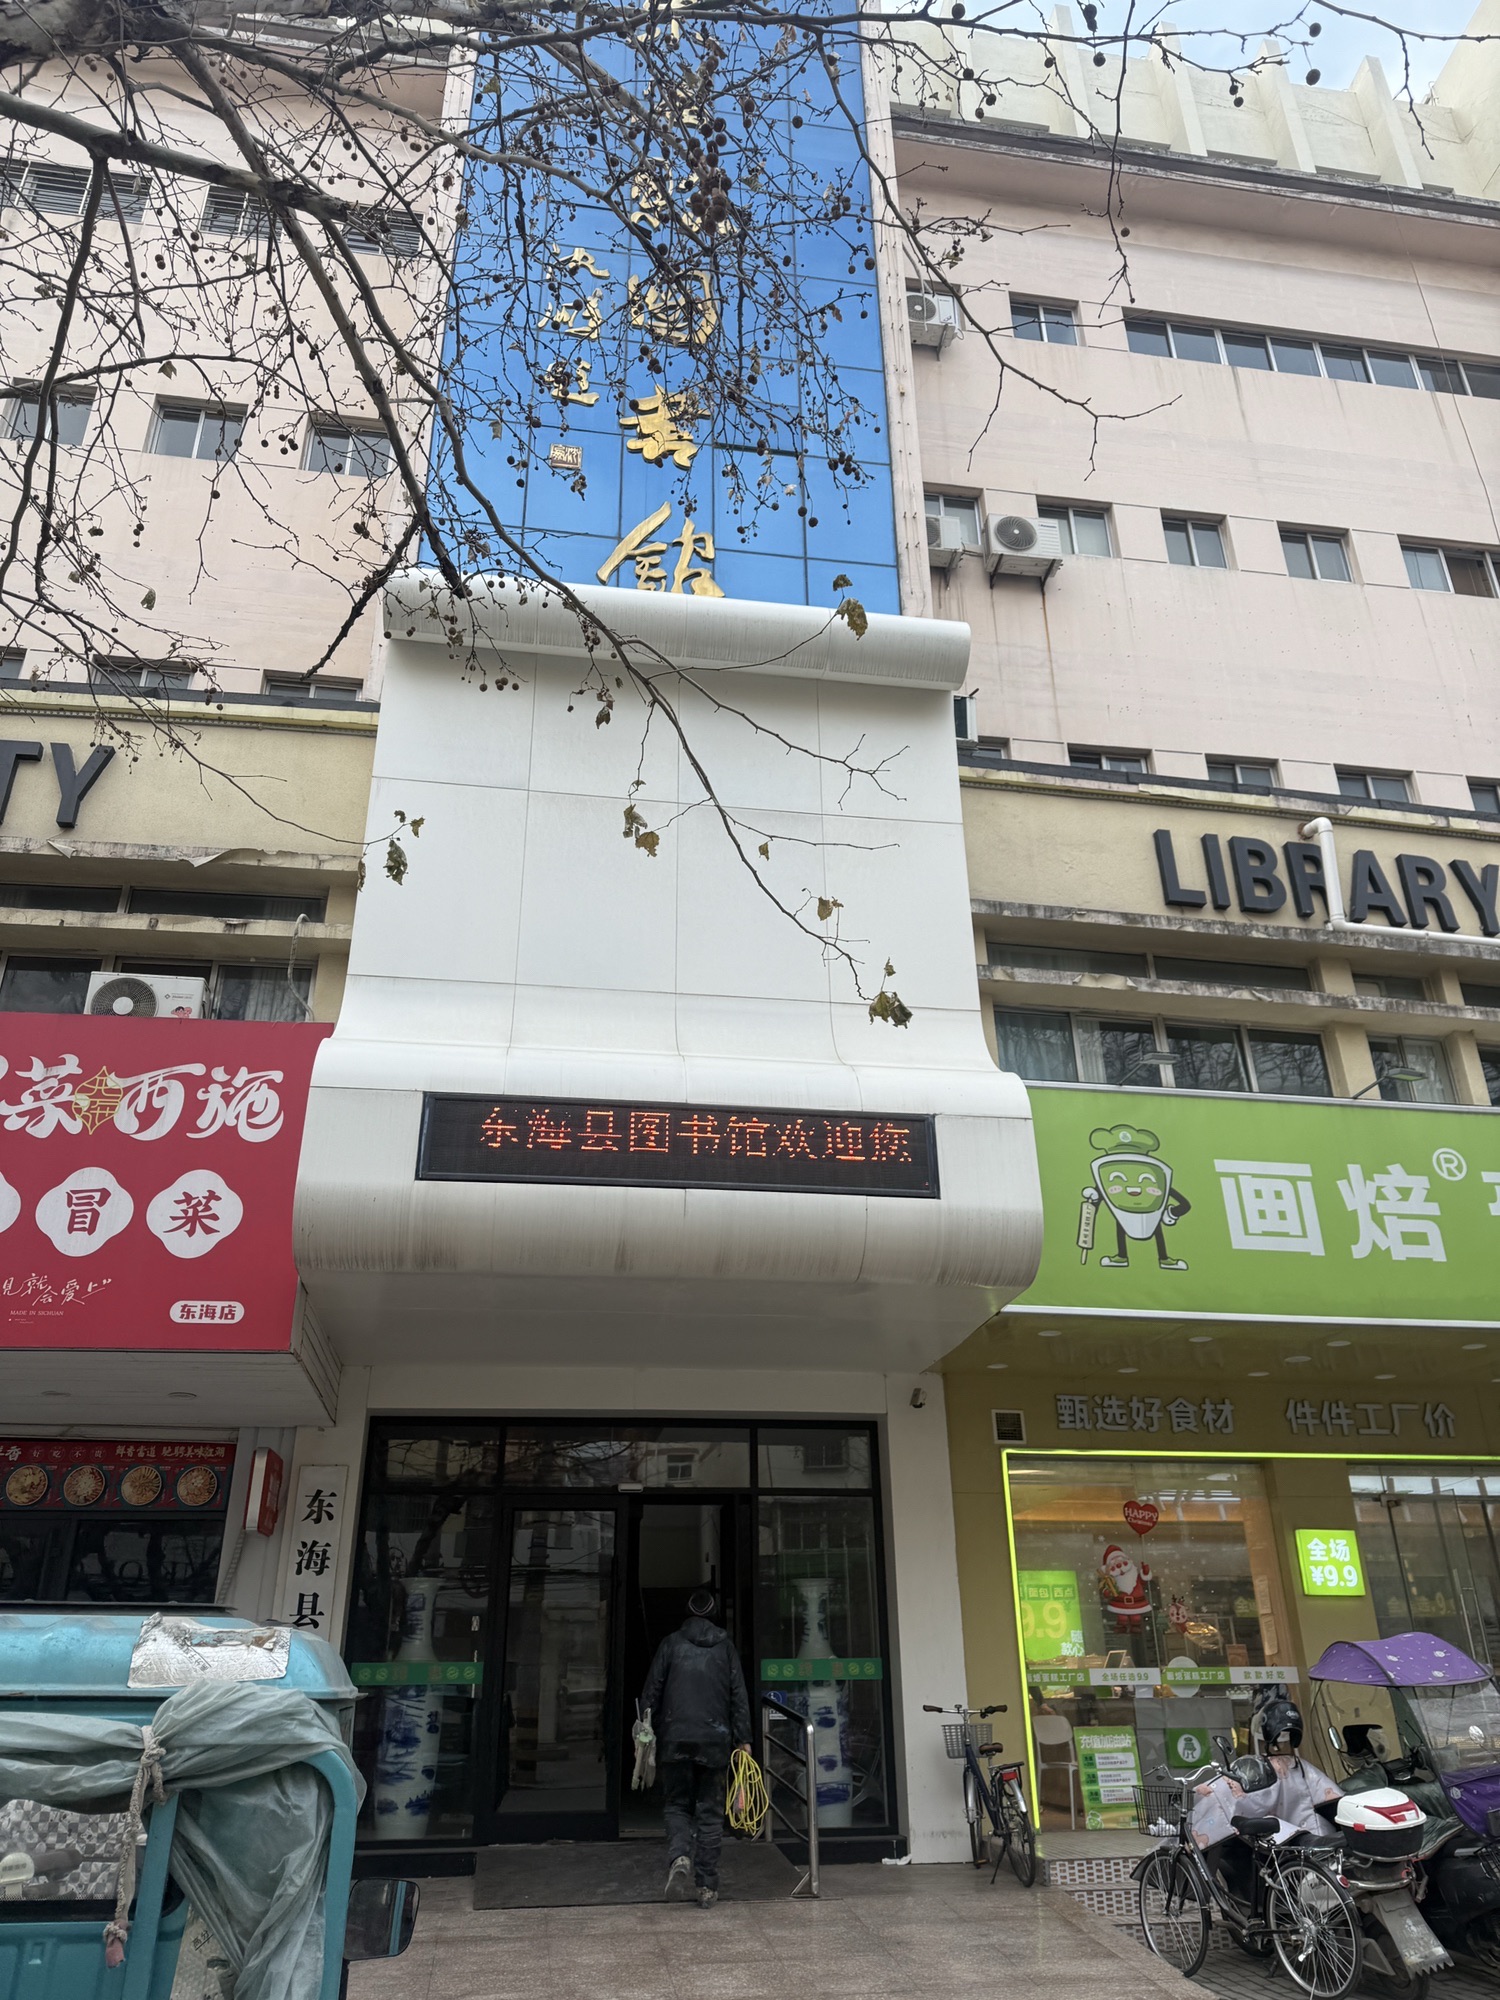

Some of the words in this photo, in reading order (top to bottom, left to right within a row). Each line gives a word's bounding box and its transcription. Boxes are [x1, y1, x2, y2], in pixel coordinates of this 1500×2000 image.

[1153, 829, 1500, 937] LIBRARY
[0, 1053, 285, 1143] 菜西施
[480, 1106, 912, 1162] 东海县图书馆欢迎您
[179, 1304, 238, 1321] 东海店
[1056, 1394, 1235, 1434] 甄选好食材
[1285, 1399, 1456, 1438] 件件工厂价
[1124, 1507, 1158, 1521] HAPPY
[289, 1489, 338, 1630] 东海县
[1306, 1537, 1351, 1563] 全场
[1310, 1564, 1359, 1587] ¥9.9
[1243, 1670, 1286, 1680] 款款好吃
